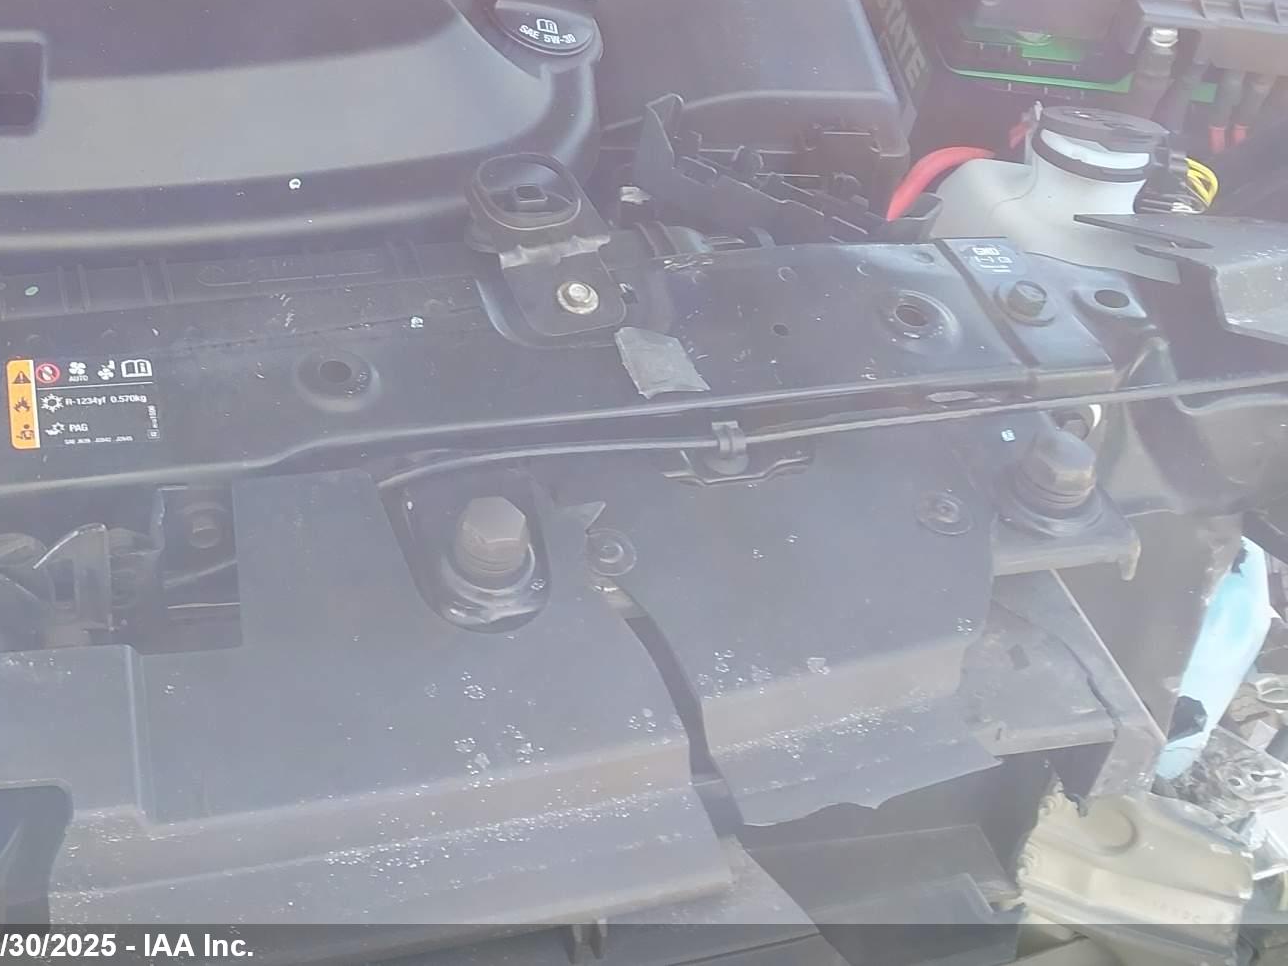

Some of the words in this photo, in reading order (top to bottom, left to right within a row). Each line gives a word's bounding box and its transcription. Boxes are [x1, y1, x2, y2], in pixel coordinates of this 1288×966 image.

[518, 24, 540, 40] SAE
[543, 33, 577, 45] 5W-30
[68, 423, 89, 433] PAG
